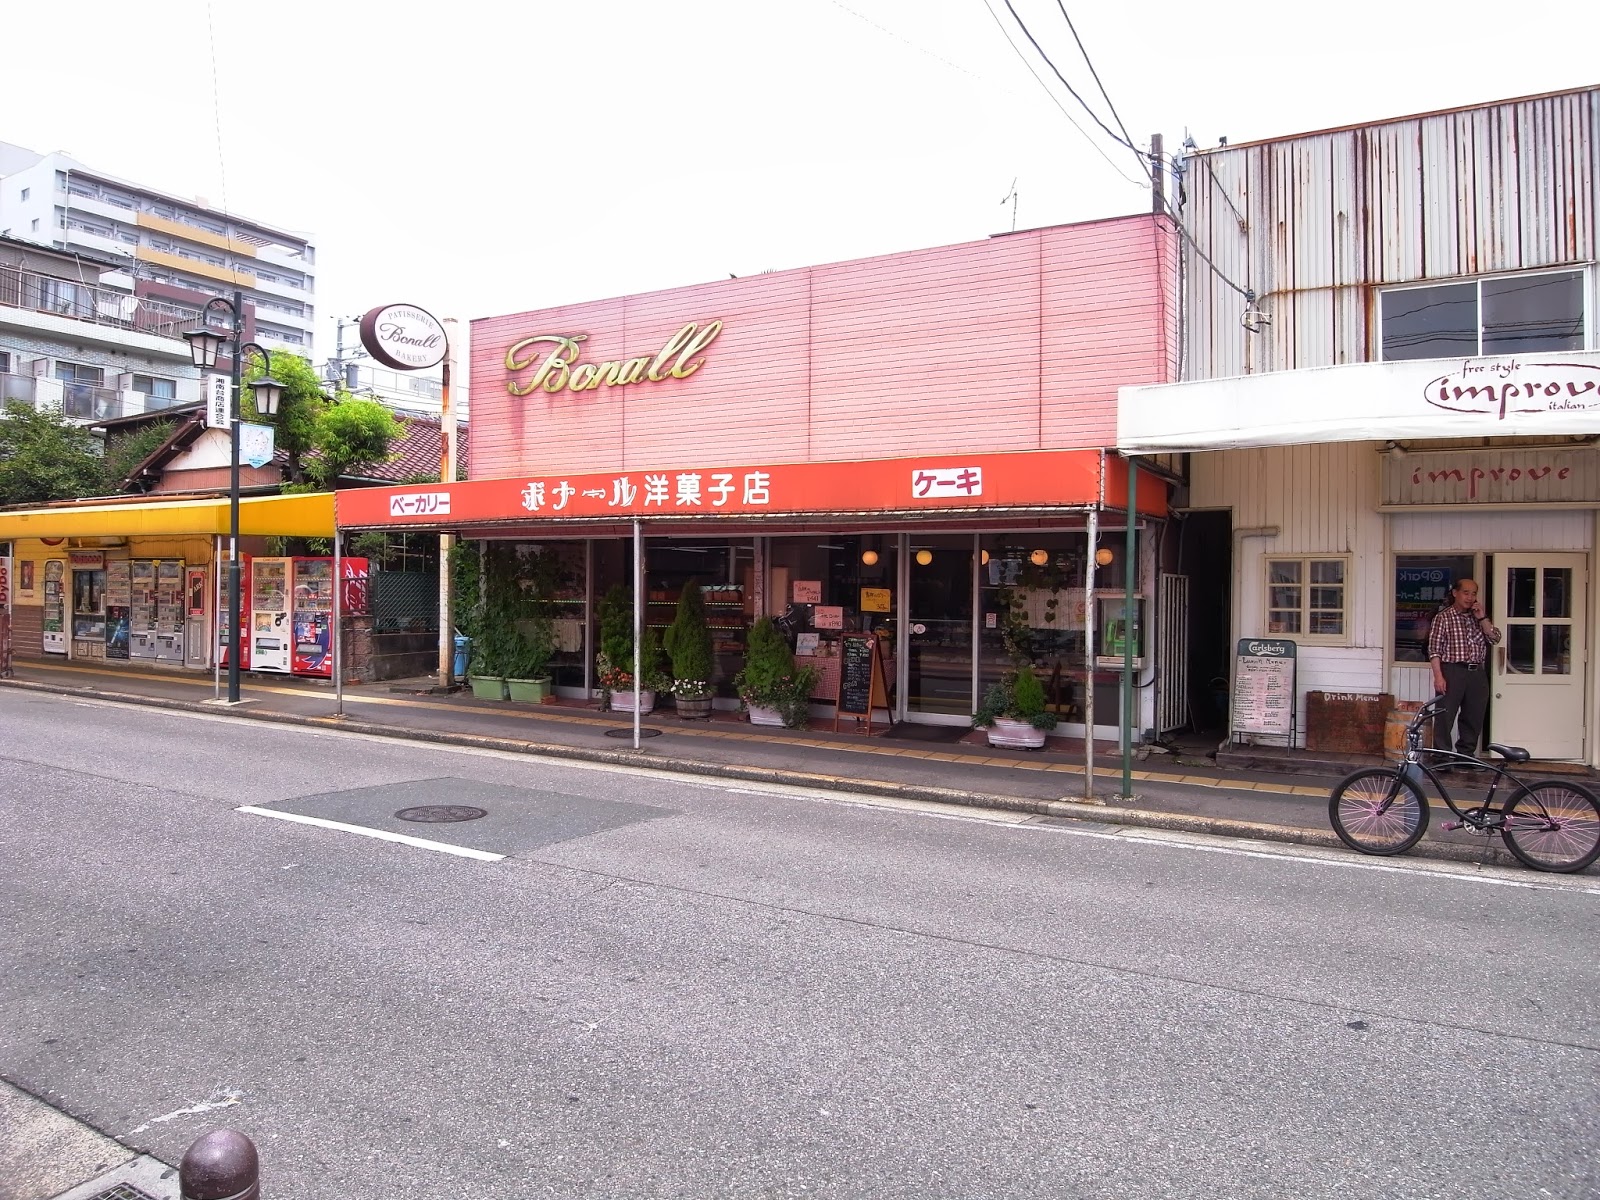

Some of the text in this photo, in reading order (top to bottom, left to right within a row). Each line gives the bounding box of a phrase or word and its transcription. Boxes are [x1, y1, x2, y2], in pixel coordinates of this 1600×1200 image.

[388, 311, 434, 330] PATISSERIE
[380, 323, 441, 348] Bonall
[396, 350, 427, 362] BAKERY
[505, 320, 723, 396] Bonall
[1463, 359, 1521, 379] free style
[1440, 377, 1600, 420] improv
[1548, 399, 1586, 411] italian
[914, 469, 981, 496] ケーキ
[1412, 466, 1570, 499] improve
[392, 495, 450, 513] ベーカリー
[1248, 641, 1285, 656] Carlsberg
[1324, 693, 1380, 702] Drink Menu
